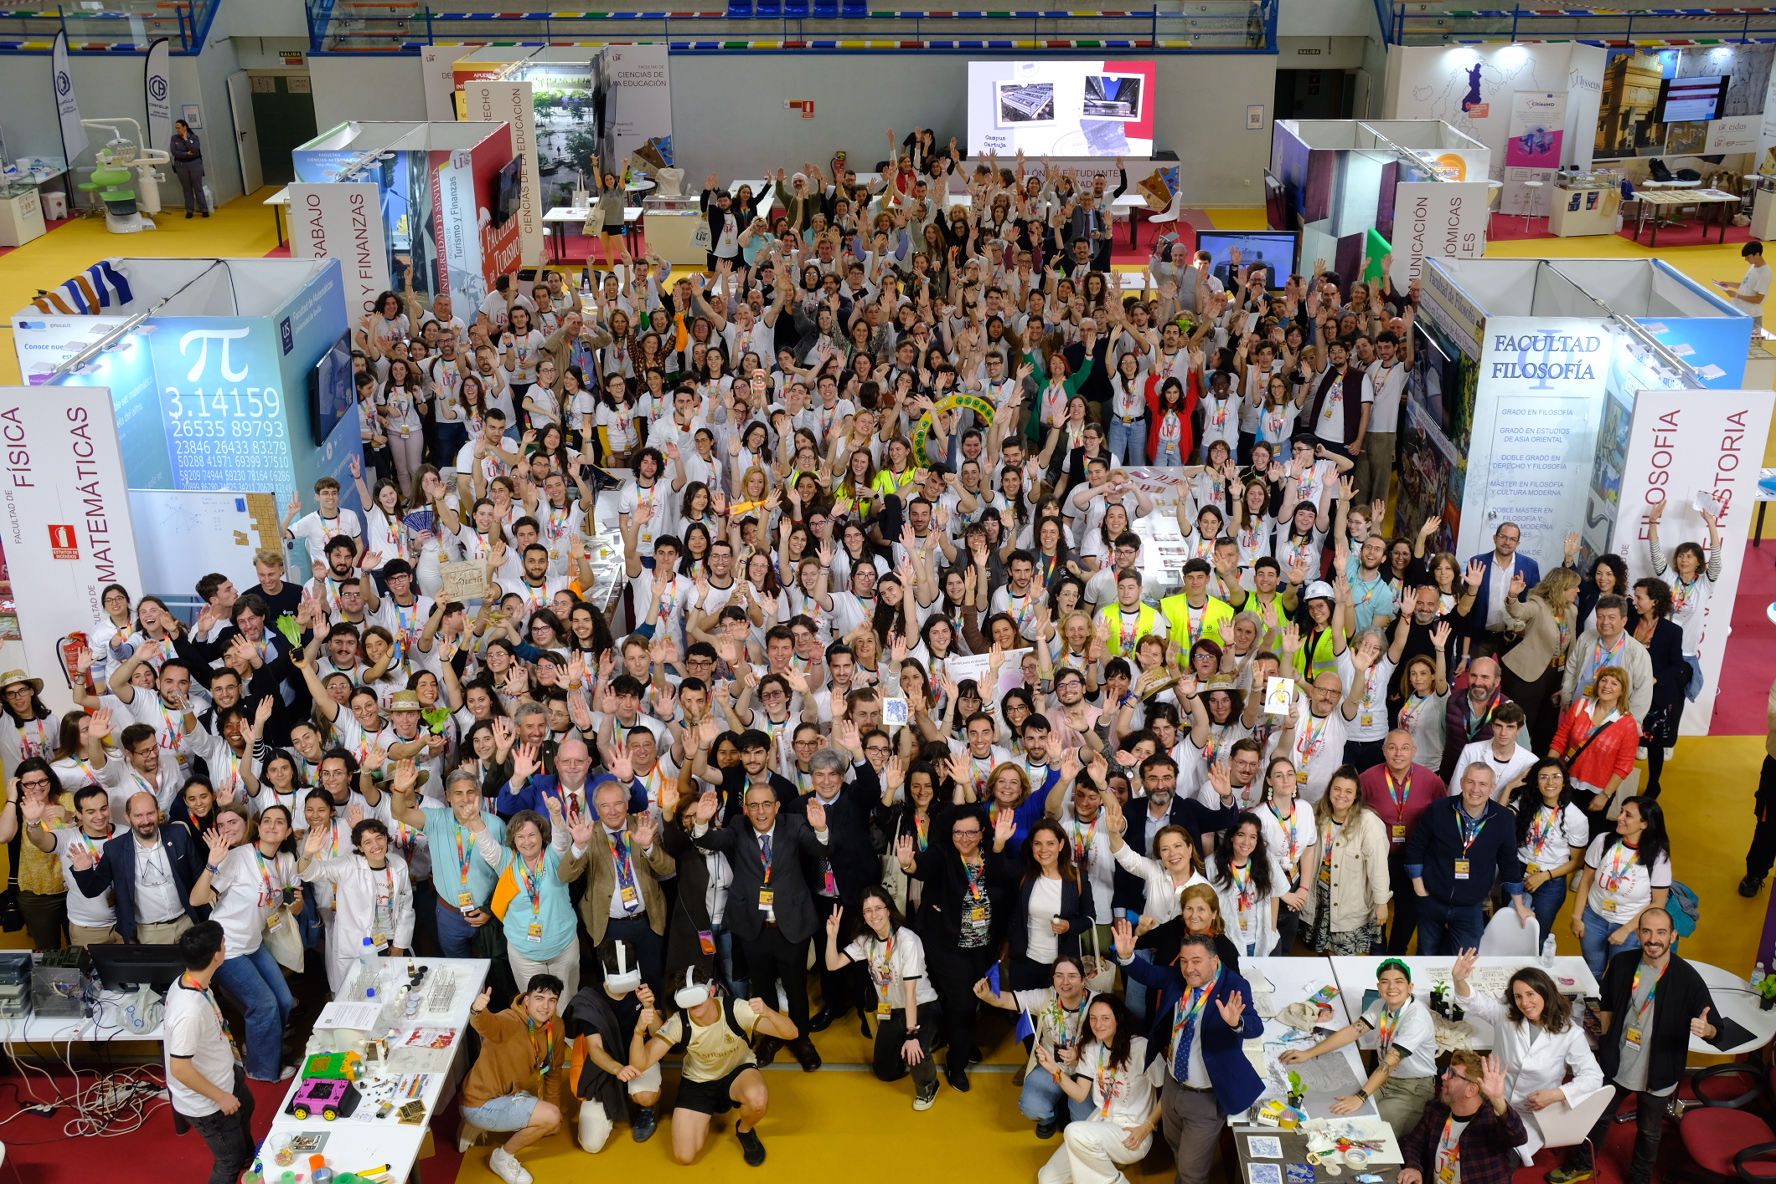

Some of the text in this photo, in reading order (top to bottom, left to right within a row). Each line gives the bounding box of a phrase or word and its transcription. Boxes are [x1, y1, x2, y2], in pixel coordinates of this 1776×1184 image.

[512, 88, 526, 151] EDUCACIÓN
[431, 167, 444, 212] SEVILLA
[522, 168, 528, 179] DE
[450, 176, 462, 216] Finanzas
[521, 186, 532, 234] CIENCIAS
[306, 194, 327, 258] RABAJO
[350, 193, 375, 279] FINANZAS
[452, 224, 463, 259] Turismo
[1443, 197, 1462, 257] ÓMICAS
[363, 285, 375, 295] Y
[1494, 335, 1600, 352] FACULTAD
[1492, 360, 1595, 380] FILOSOFÍA
[166, 387, 280, 418] 3.14159
[1, 407, 34, 487] FÍSICA
[171, 421, 284, 438] 26535 89793
[176, 441, 287, 455] 23846 26433 83279
[178, 456, 204, 467] 50288
[207, 456, 232, 467] 41971
[235, 456, 260, 468] 69399
[67, 407, 117, 582] MATEMÁTICAS
[5, 490, 22, 544] FACULTAD DE
[88, 584, 101, 625] ULTAD DE
